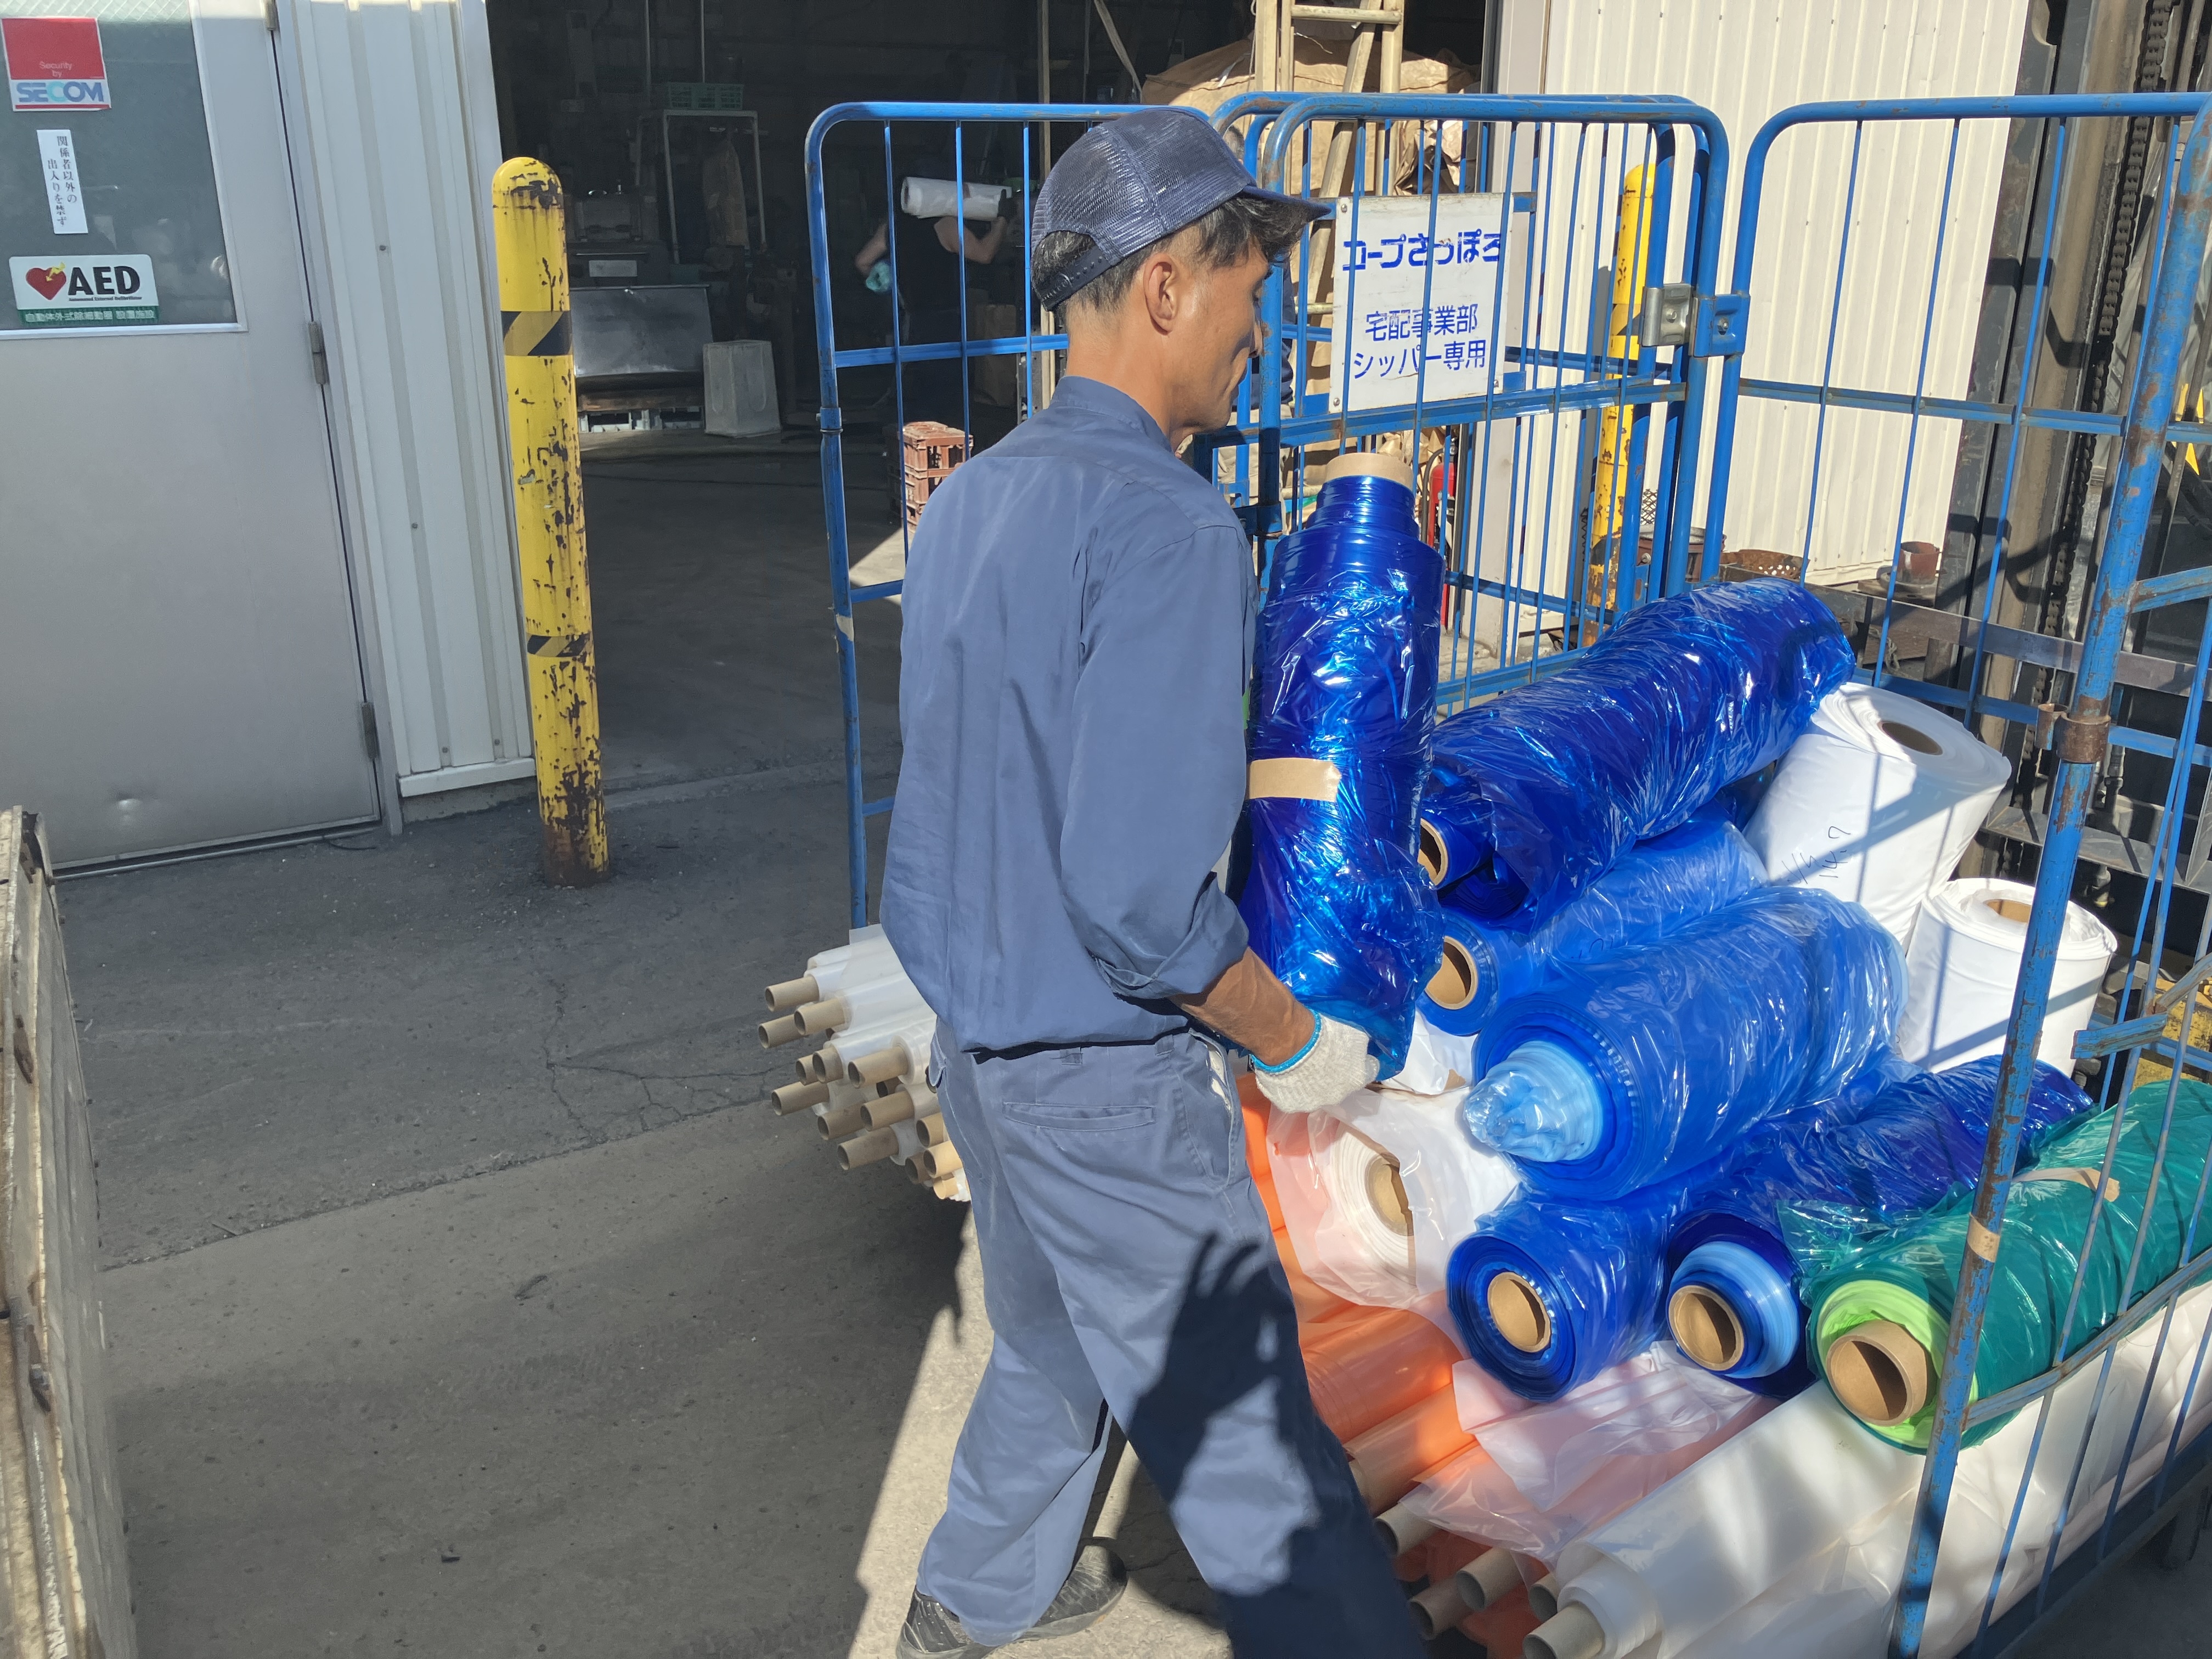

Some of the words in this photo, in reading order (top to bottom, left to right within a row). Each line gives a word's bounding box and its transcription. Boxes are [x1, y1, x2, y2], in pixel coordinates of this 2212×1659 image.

[39, 61, 72, 70] Security
[52, 70, 63, 78] by
[17, 81, 104, 102] SECOM
[57, 136, 77, 203] 関係者以外の
[48, 159, 67, 227] 出入りを禁ず
[67, 266, 140, 295] AED
[1365, 303, 1478, 342] 宅配事業部
[1353, 340, 1486, 379] シッパー専用
